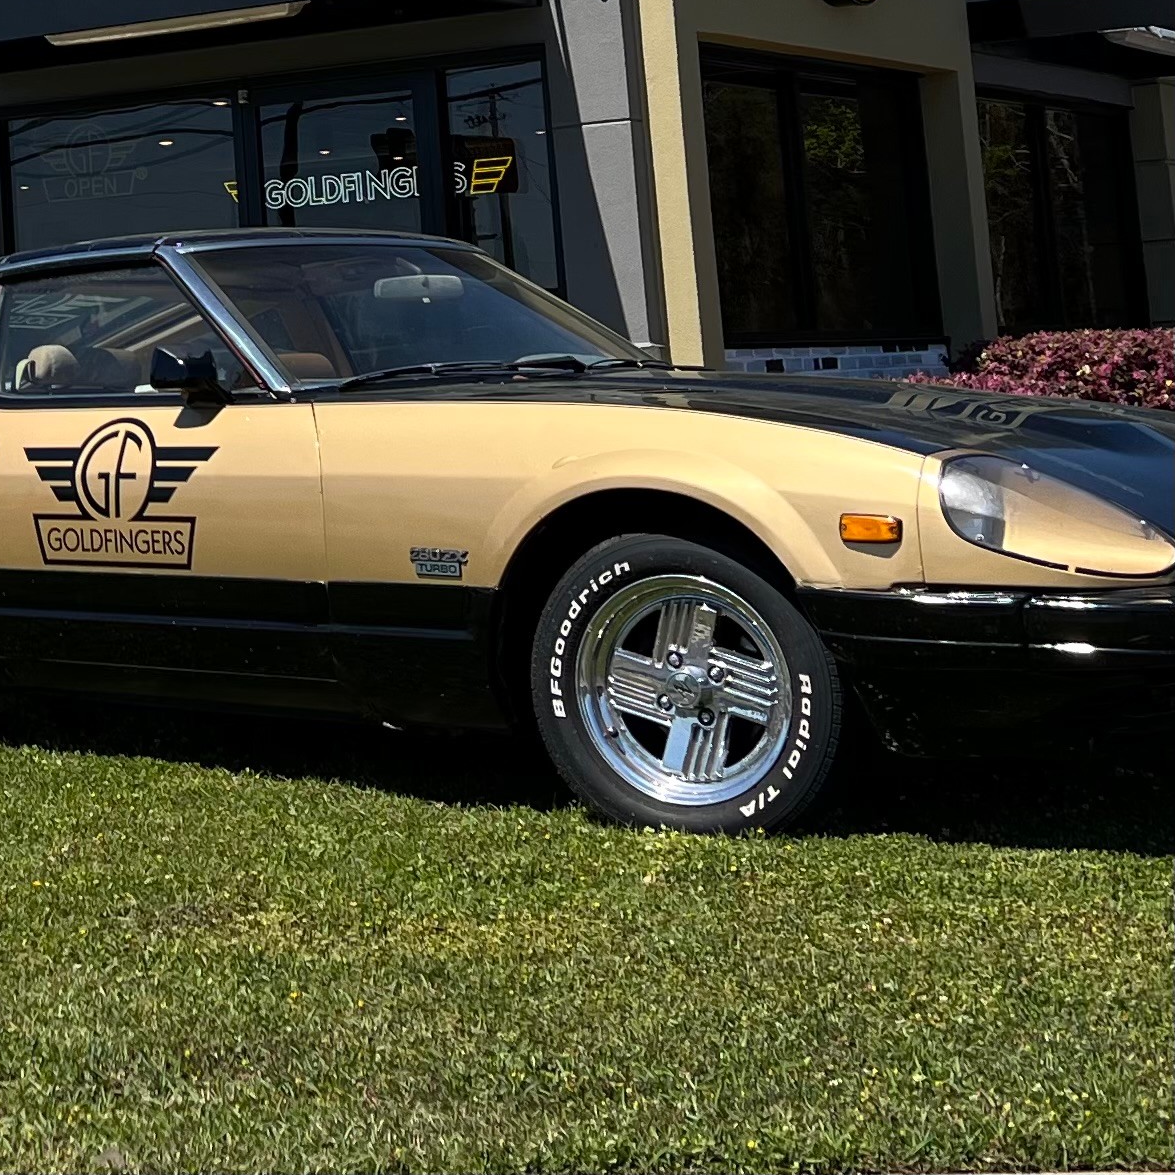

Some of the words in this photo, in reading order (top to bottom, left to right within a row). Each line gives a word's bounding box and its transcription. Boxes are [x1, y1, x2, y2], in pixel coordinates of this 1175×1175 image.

[64, 176, 118, 199] OPEN
[264, 162, 467, 209] GOLDFINGS
[81, 430, 142, 518] GF
[47, 527, 185, 555] GOLDFINGERS
[417, 563, 457, 574] TURBO
[550, 561, 631, 718] BFGoodrich
[782, 673, 813, 780] Radial
